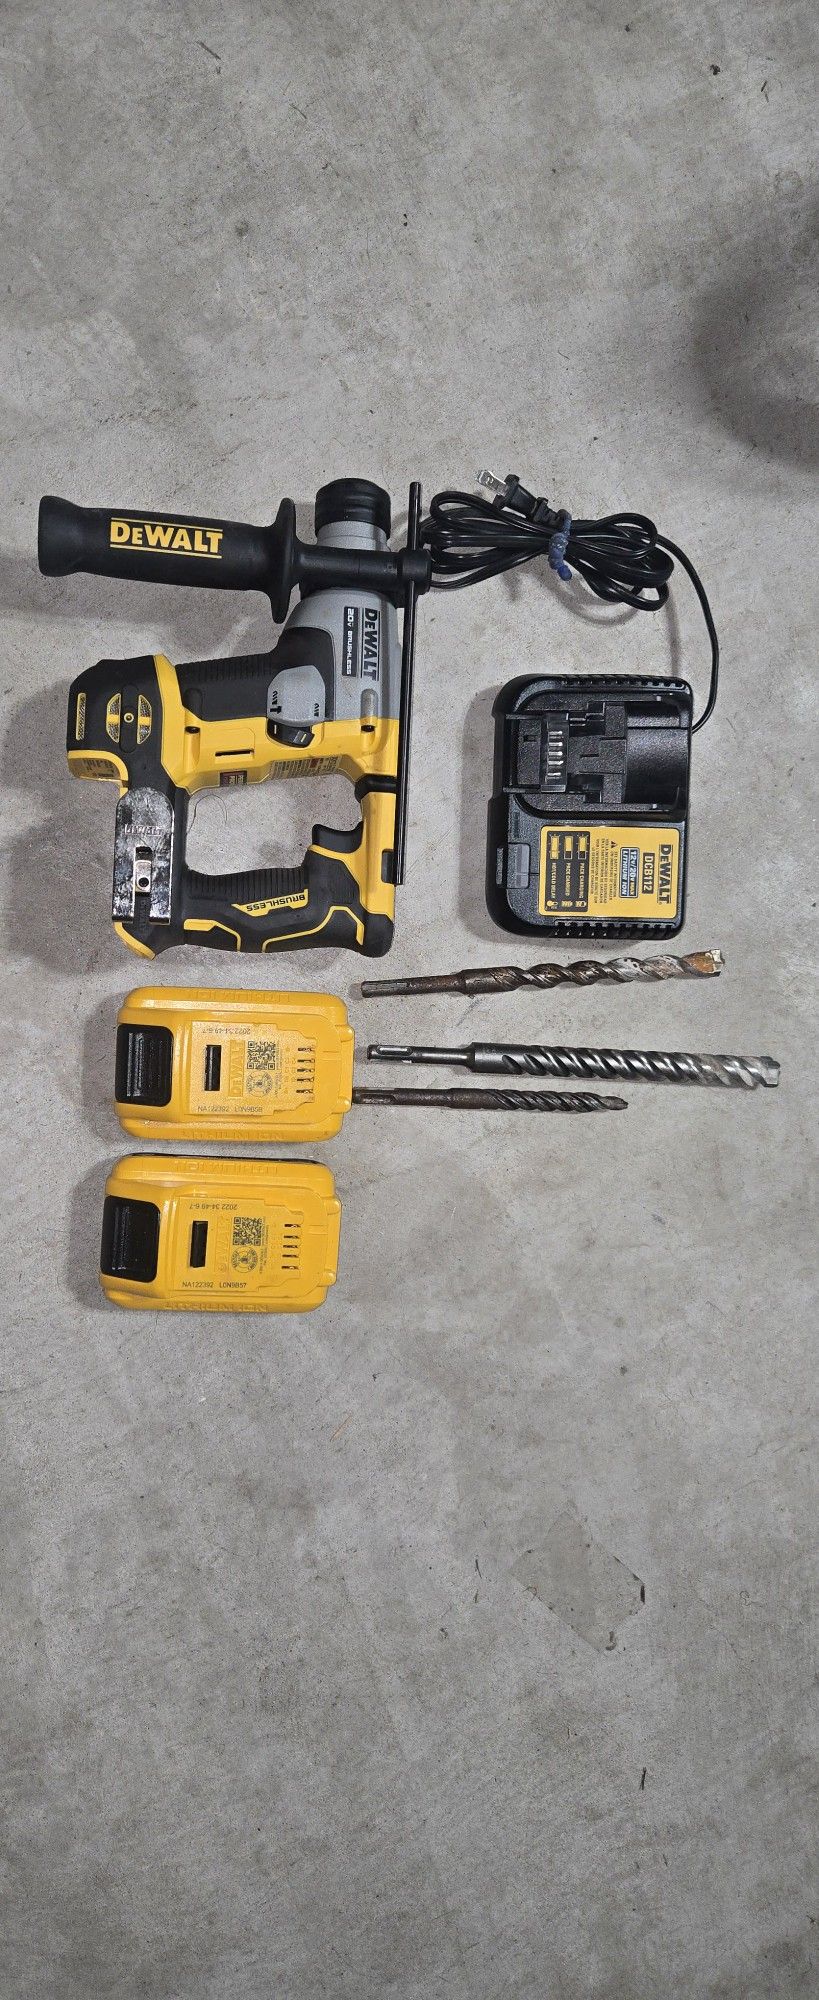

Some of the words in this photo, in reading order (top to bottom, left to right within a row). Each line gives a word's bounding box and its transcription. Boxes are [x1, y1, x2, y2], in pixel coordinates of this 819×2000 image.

[110, 521, 223, 553] DEWALT
[643, 855, 654, 891] DCB112
[246, 894, 306, 912] BRUSHLESS
